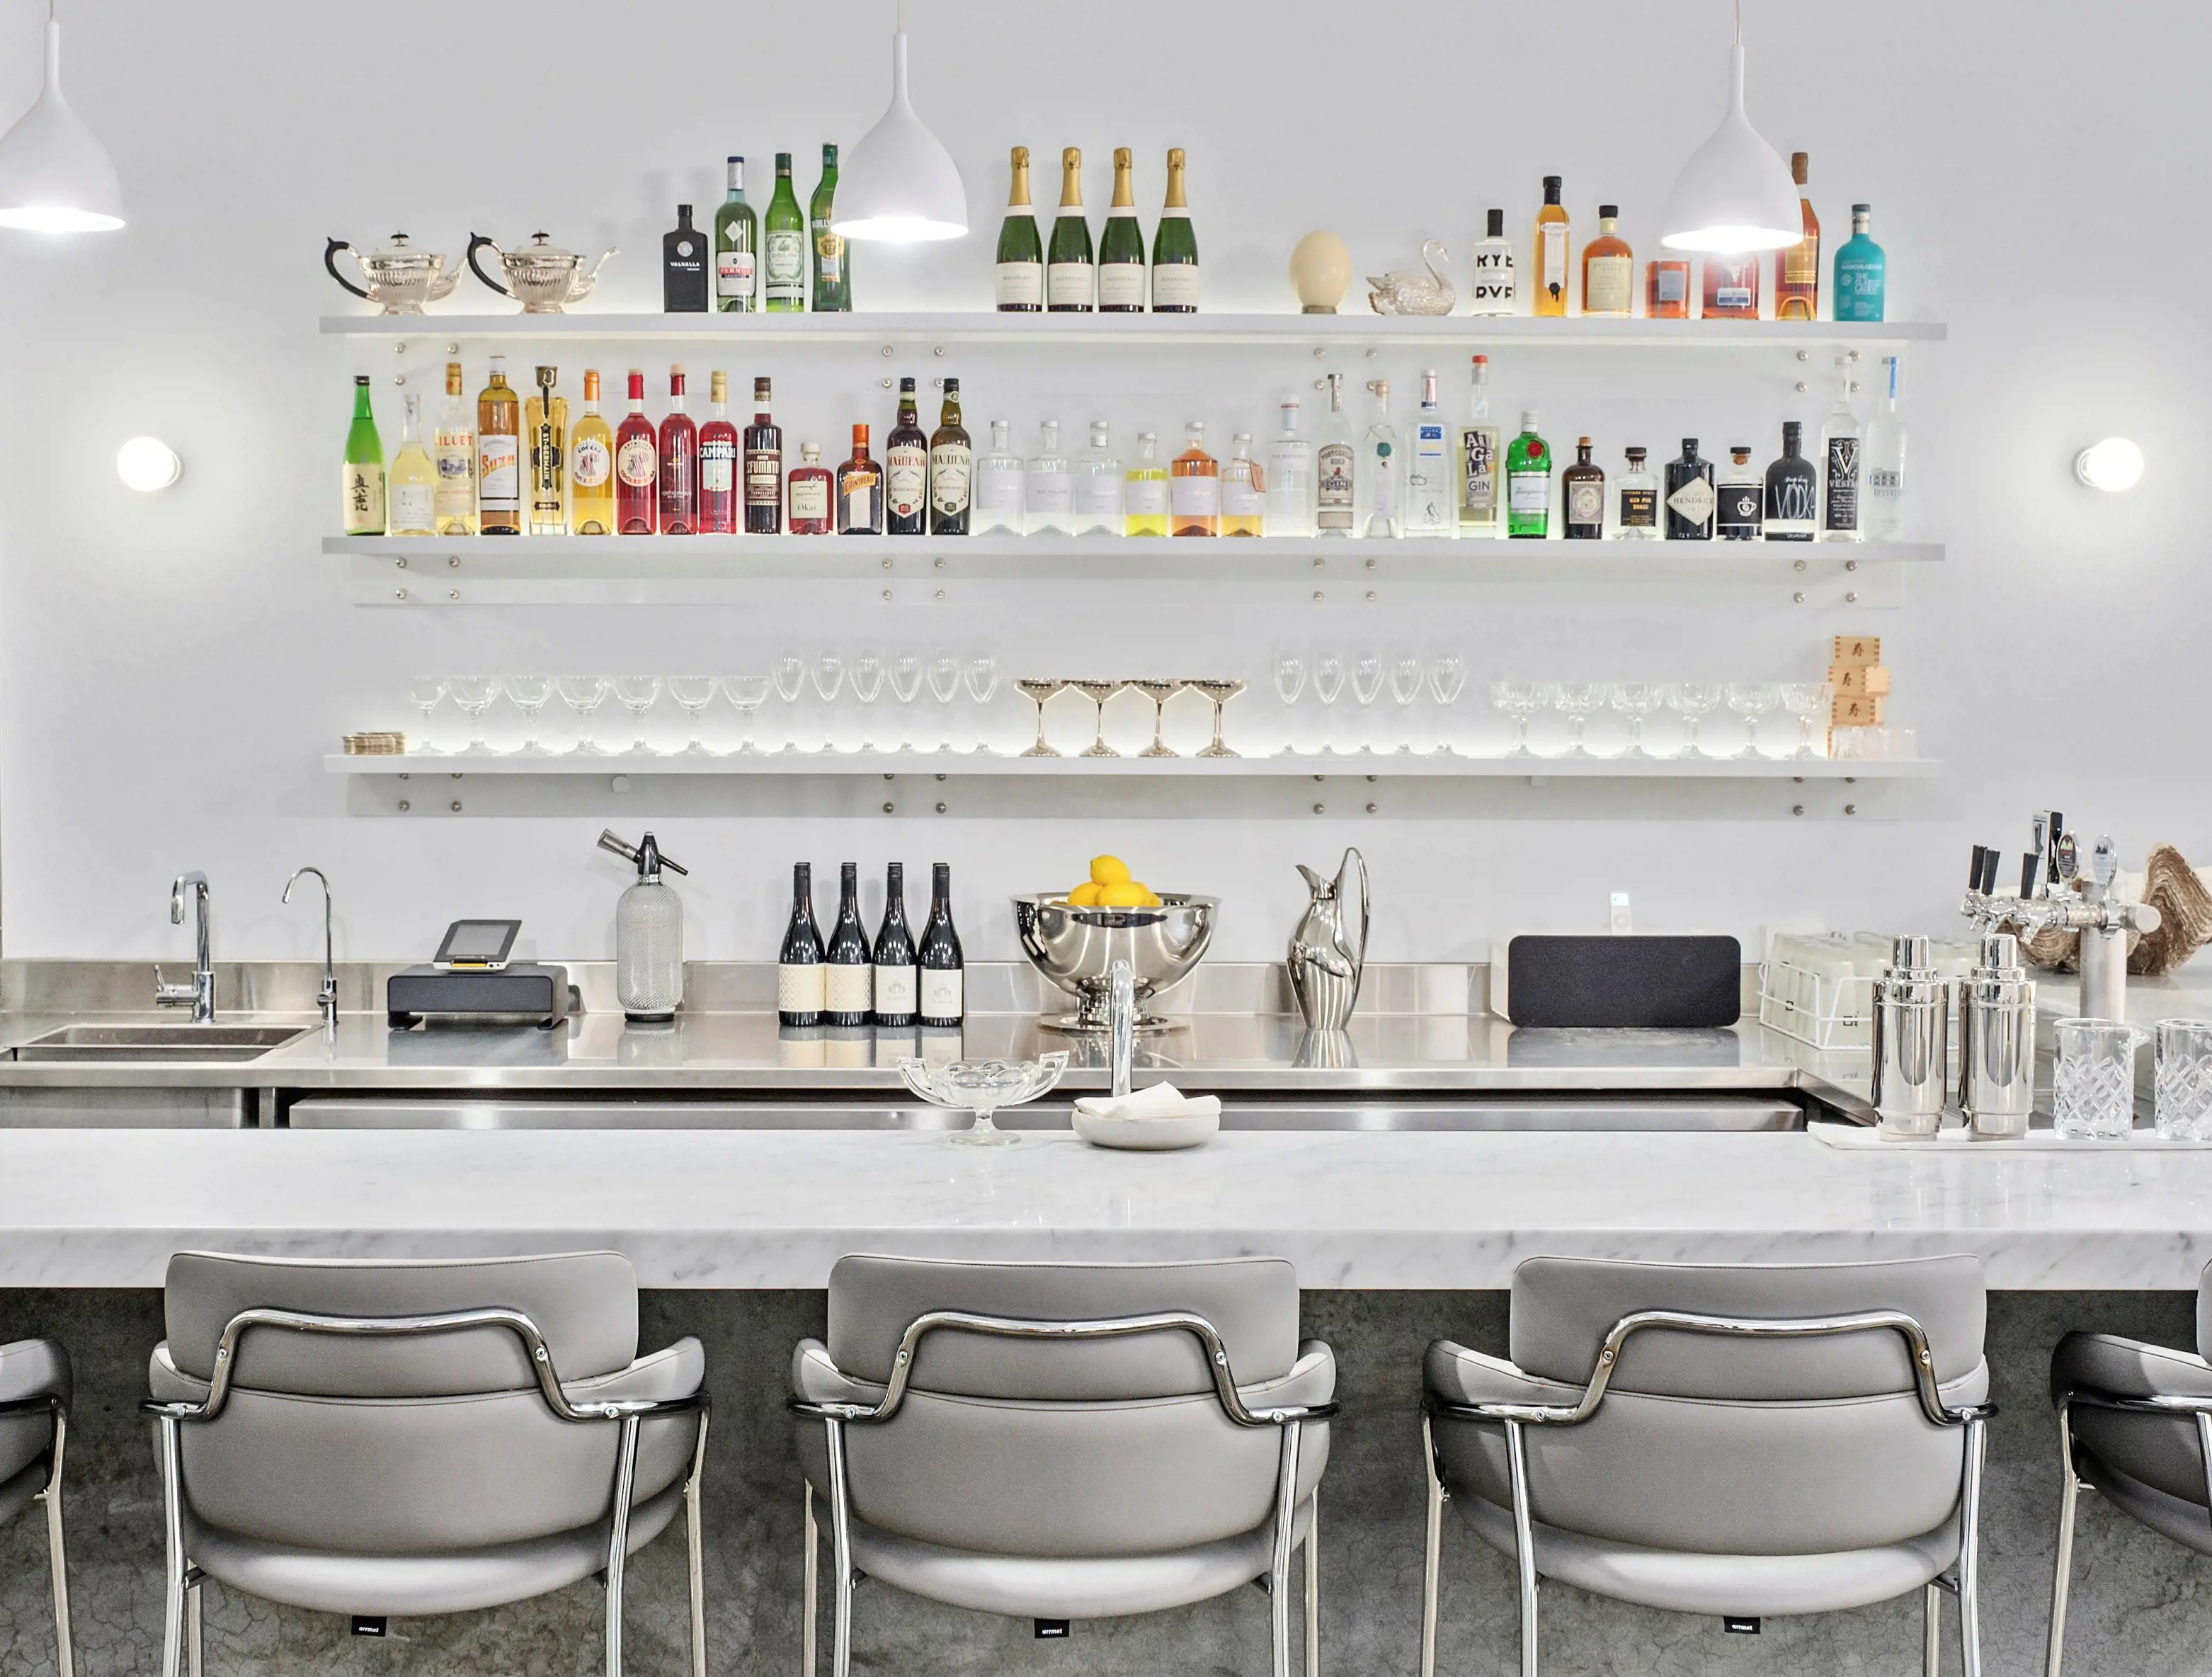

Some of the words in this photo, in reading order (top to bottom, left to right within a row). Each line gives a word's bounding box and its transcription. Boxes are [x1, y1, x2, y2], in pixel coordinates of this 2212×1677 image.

[700, 447, 736, 458] CAMPARI
[746, 460, 779, 474] SFUMATO
[1469, 481, 1490, 491] GIN
